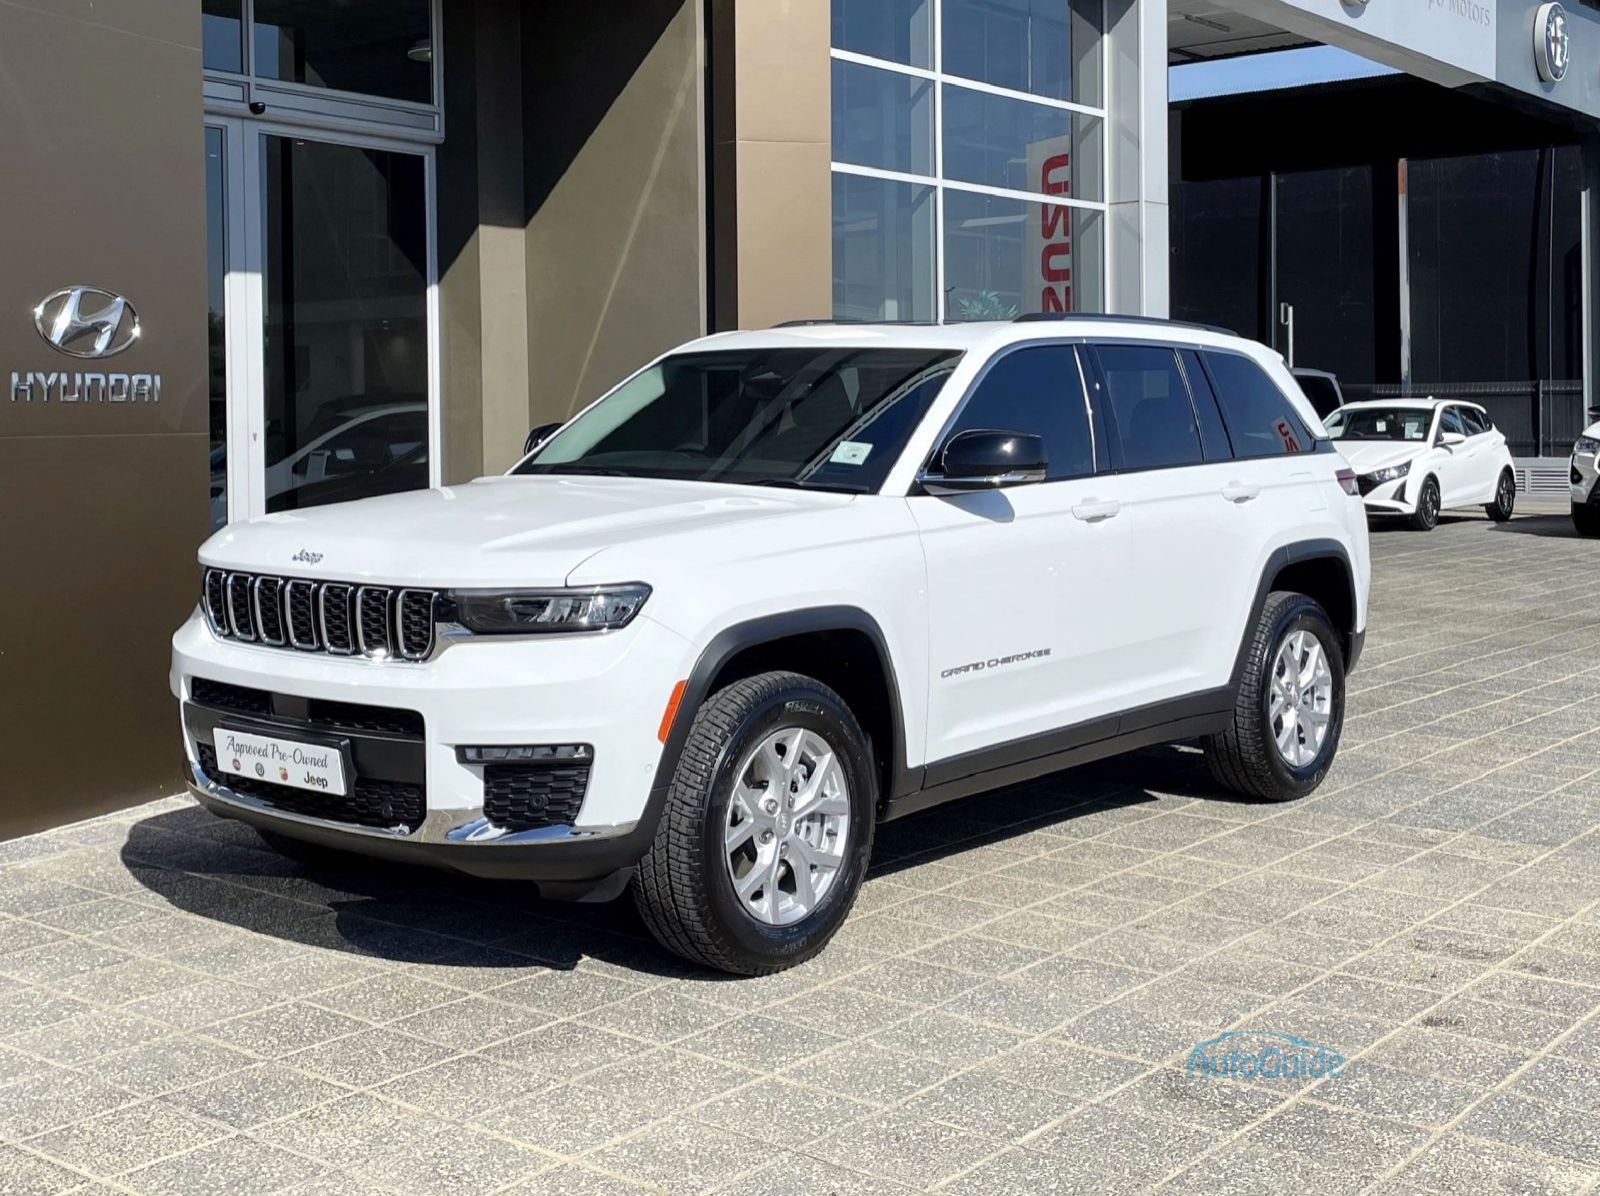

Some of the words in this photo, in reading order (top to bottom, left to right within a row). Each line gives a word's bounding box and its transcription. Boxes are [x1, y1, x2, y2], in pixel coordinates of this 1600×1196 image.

[11, 371, 161, 403] HYUNDAI
[941, 661, 985, 678] GRAND
[987, 648, 1051, 668] CHEROKEE
[226, 735, 269, 758] Approved
[270, 743, 328, 768] Pre-Owned
[304, 771, 328, 789] Jeep
